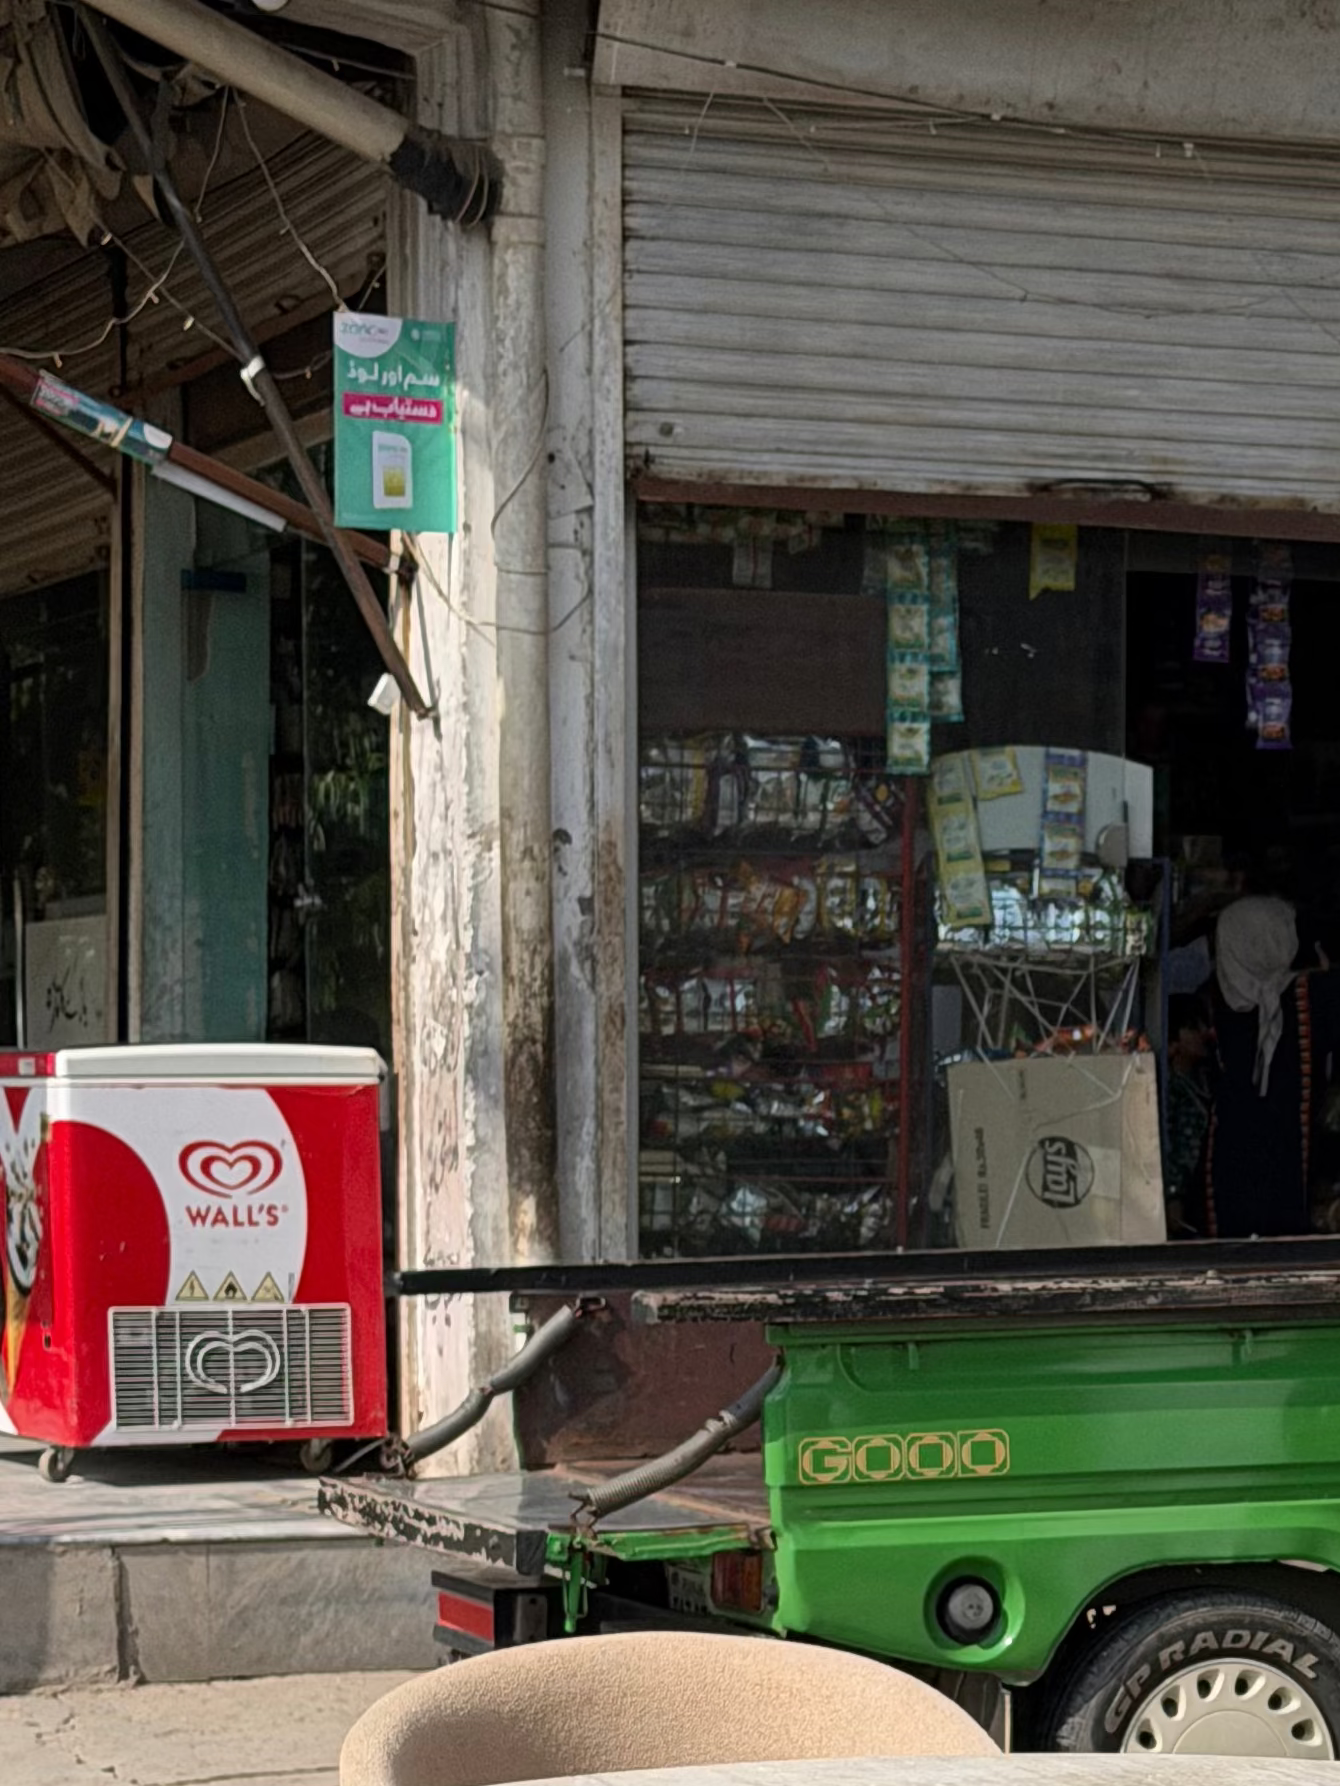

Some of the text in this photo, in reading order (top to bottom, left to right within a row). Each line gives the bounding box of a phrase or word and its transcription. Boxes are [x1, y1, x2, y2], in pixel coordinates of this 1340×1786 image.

[381, 364, 403, 388] اور
[404, 370, 440, 391] سم
[372, 396, 438, 420] دستیاب
[184, 1203, 279, 1228] WALL'S
[1158, 1629, 1322, 1681] RADIAL
